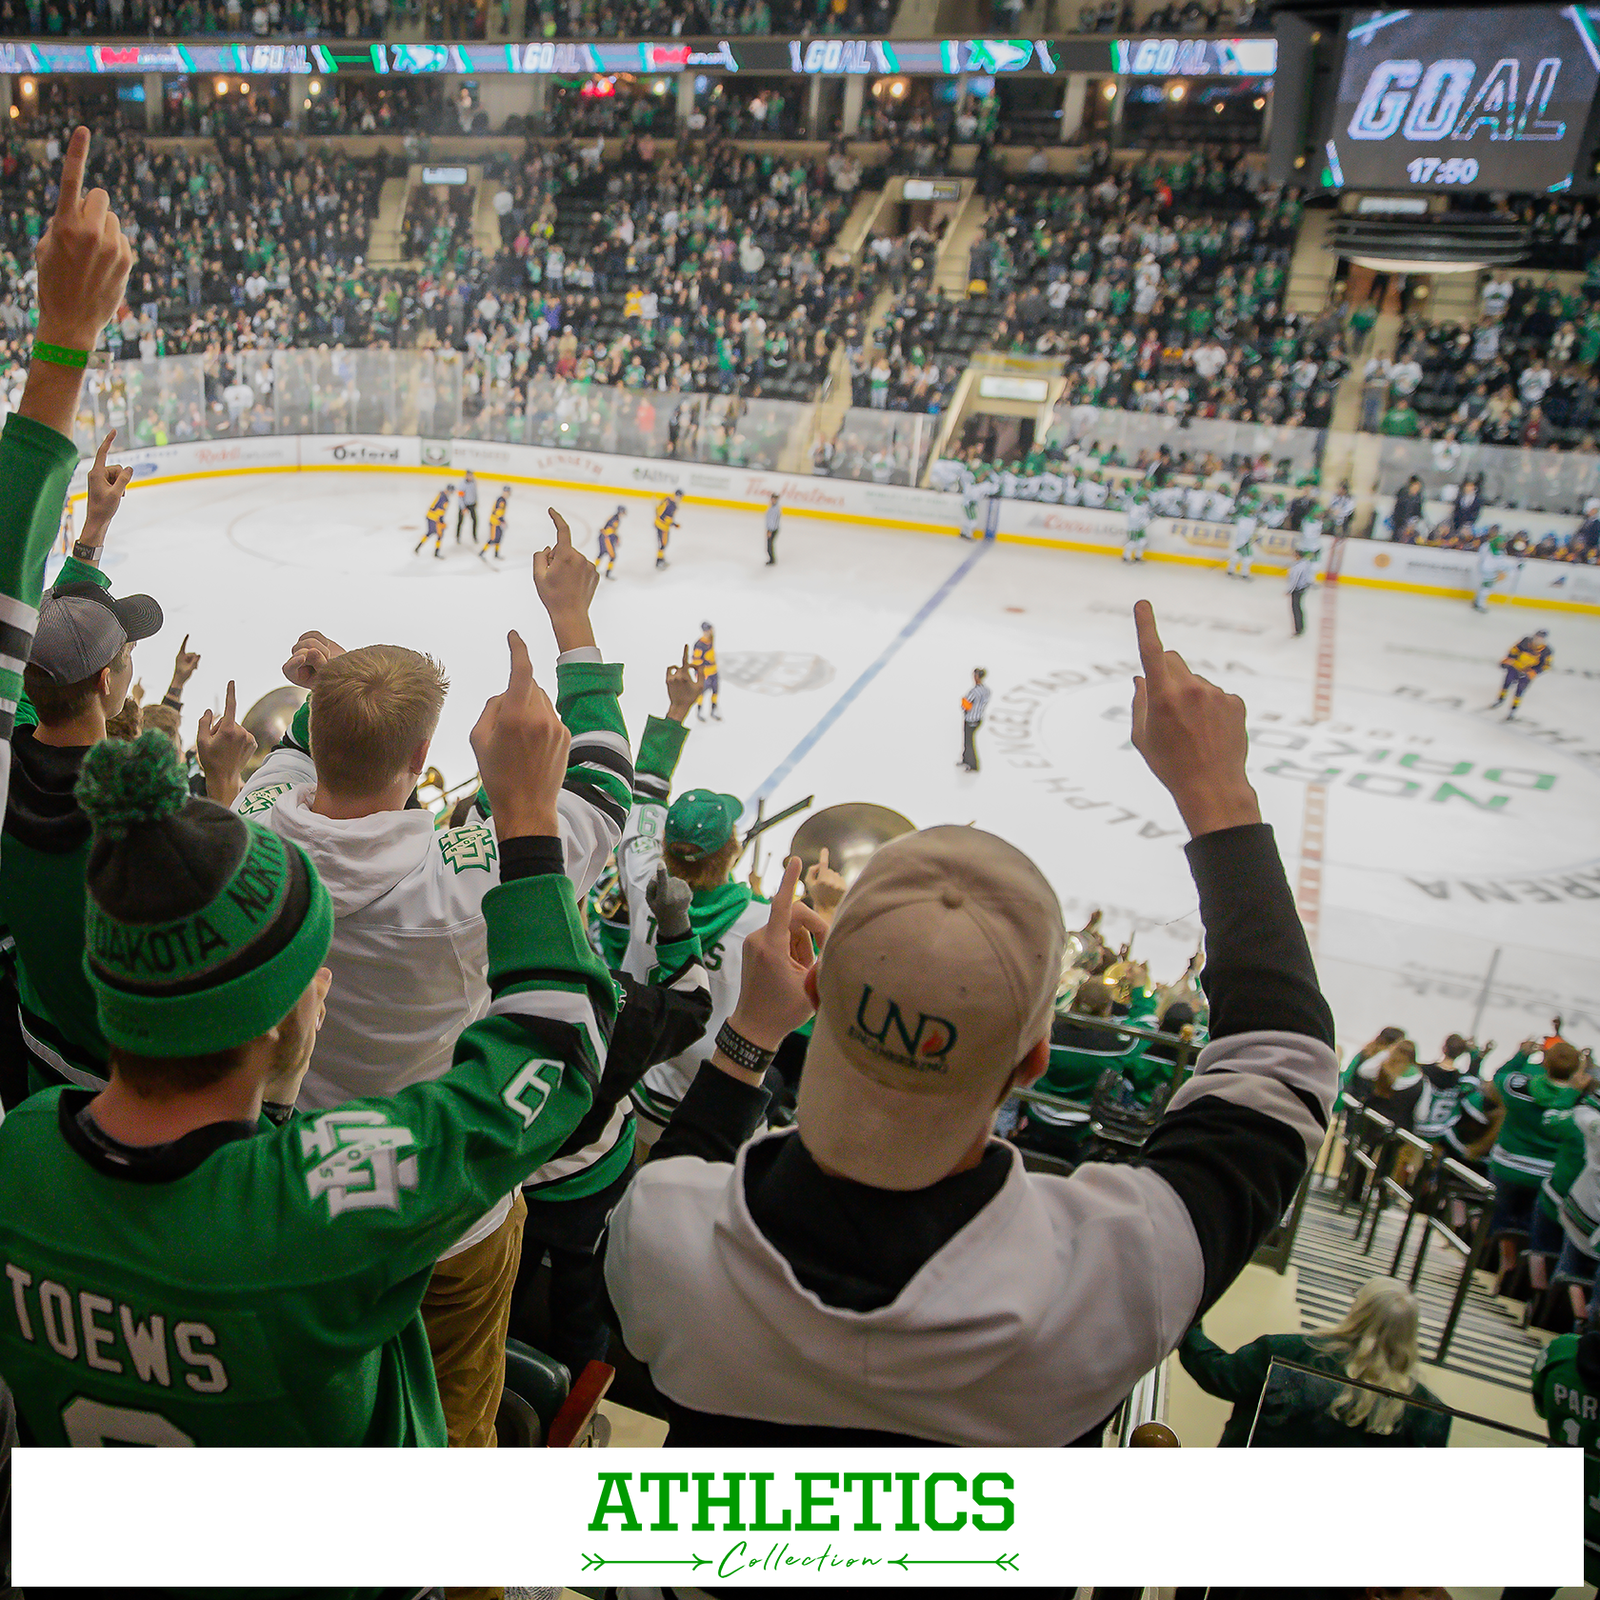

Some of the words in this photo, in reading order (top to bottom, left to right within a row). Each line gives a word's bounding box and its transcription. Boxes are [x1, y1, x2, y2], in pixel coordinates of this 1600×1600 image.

[252, 44, 312, 74] GOAL
[522, 43, 580, 73] GOAL
[803, 40, 871, 74] GOAL
[1131, 39, 1210, 75] GOAL
[1347, 58, 1567, 141] GOAL
[1406, 157, 1480, 185] 17:50
[333, 445, 399, 460] Oxford
[1031, 777, 1186, 851] ALPH
[857, 982, 958, 1057] UND
[5, 1262, 229, 1393] TOEWS
